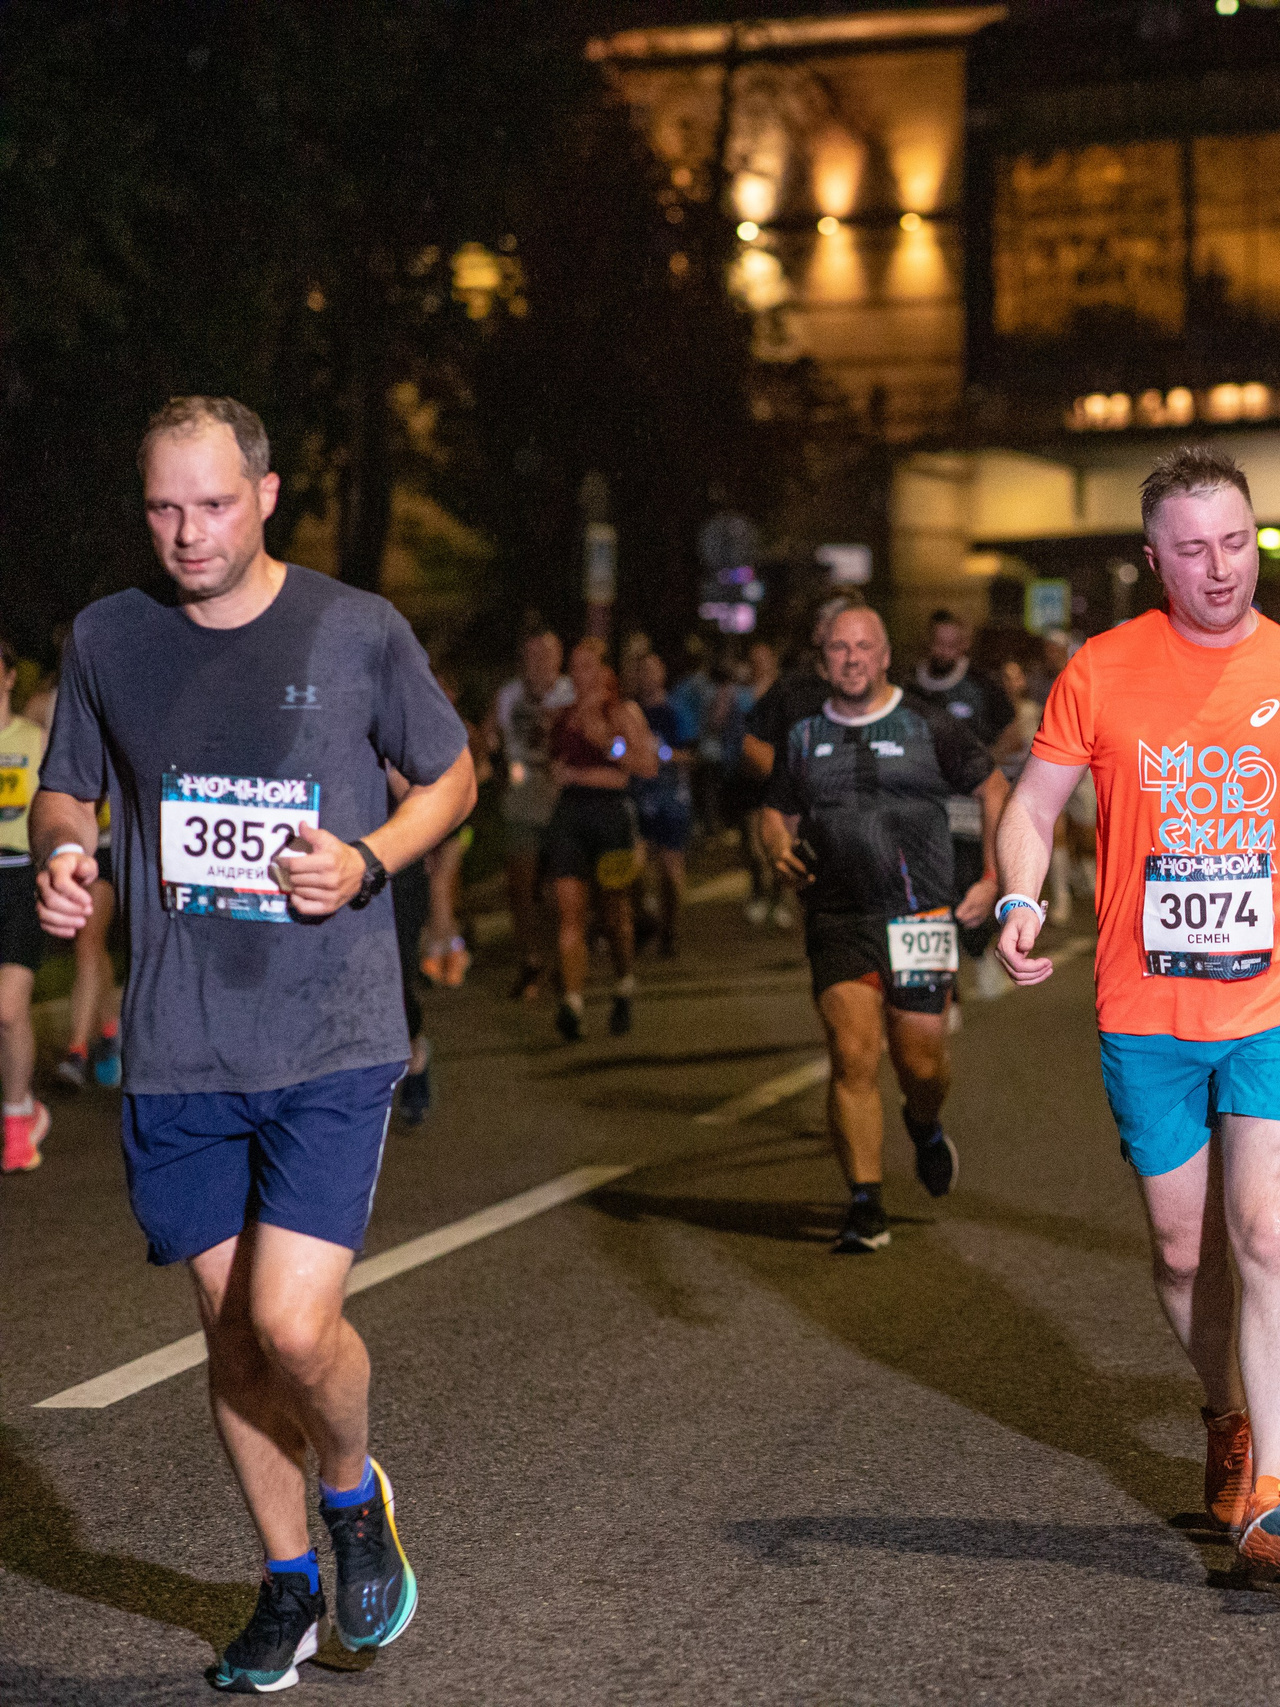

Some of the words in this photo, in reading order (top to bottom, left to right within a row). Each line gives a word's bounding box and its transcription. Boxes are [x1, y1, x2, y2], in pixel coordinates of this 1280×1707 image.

[1161, 745, 1261, 778] МОС
[1160, 782, 1245, 814] КОВ
[183, 816, 295, 862] 3852
[1159, 808, 1275, 849] СКИЙ
[207, 865, 264, 880] АНДРЕЙ
[1160, 891, 1258, 930] 3074
[1187, 933, 1230, 944] СЕМЕН
[1159, 955, 1172, 973] F
